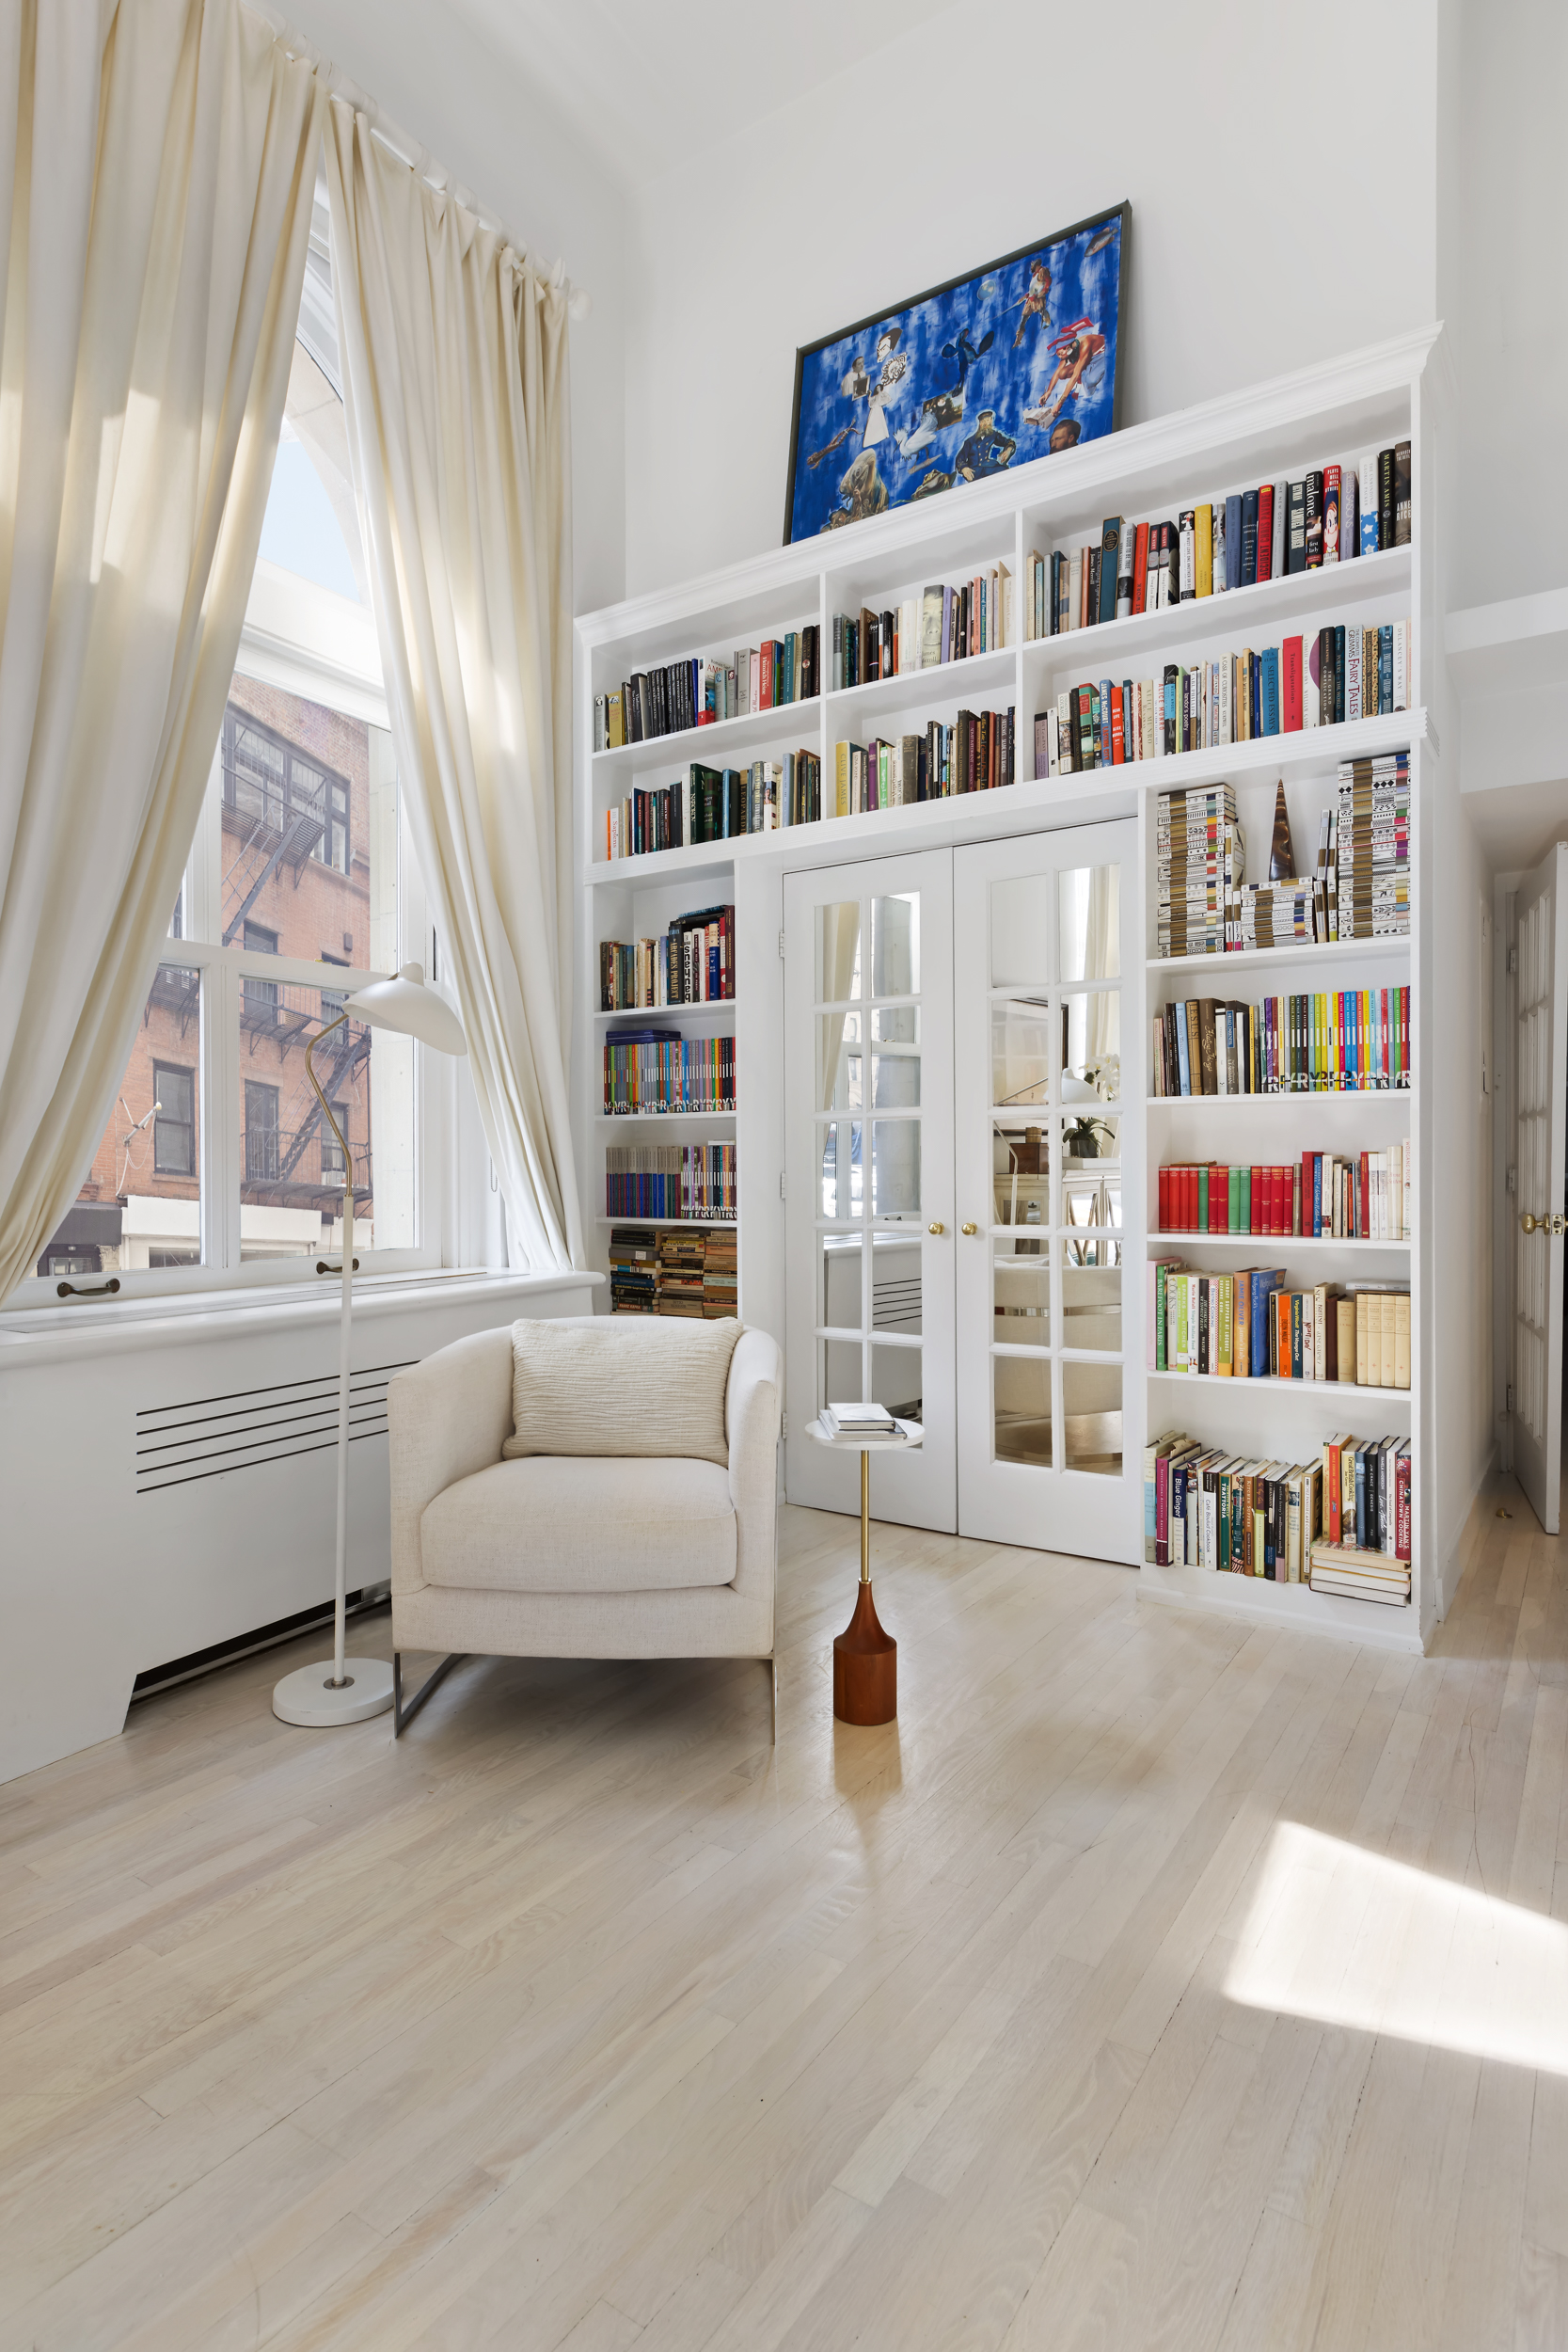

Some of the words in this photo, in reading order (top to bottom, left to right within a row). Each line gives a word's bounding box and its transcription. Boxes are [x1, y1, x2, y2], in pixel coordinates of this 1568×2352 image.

[1307, 474, 1319, 517] malone
[1346, 473, 1354, 493] BELLES
[1261, 495, 1271, 521] PAVONE
[1346, 494, 1354, 528] SAISONS
[1396, 500, 1411, 512] ANNE
[1396, 510, 1411, 521] RICE
[1260, 522, 1270, 543] CHRIS
[1259, 545, 1269, 577] ACCIDENT
[1348, 658, 1360, 684] FAIRY
[1348, 684, 1360, 715] TALES
[670, 942, 678, 969] ARCADES
[670, 970, 679, 999] PROJECT
[1189, 1001, 1199, 1037] JESUS
[1157, 1316, 1163, 1325] IN
[1303, 1322, 1311, 1337] NIGHT
